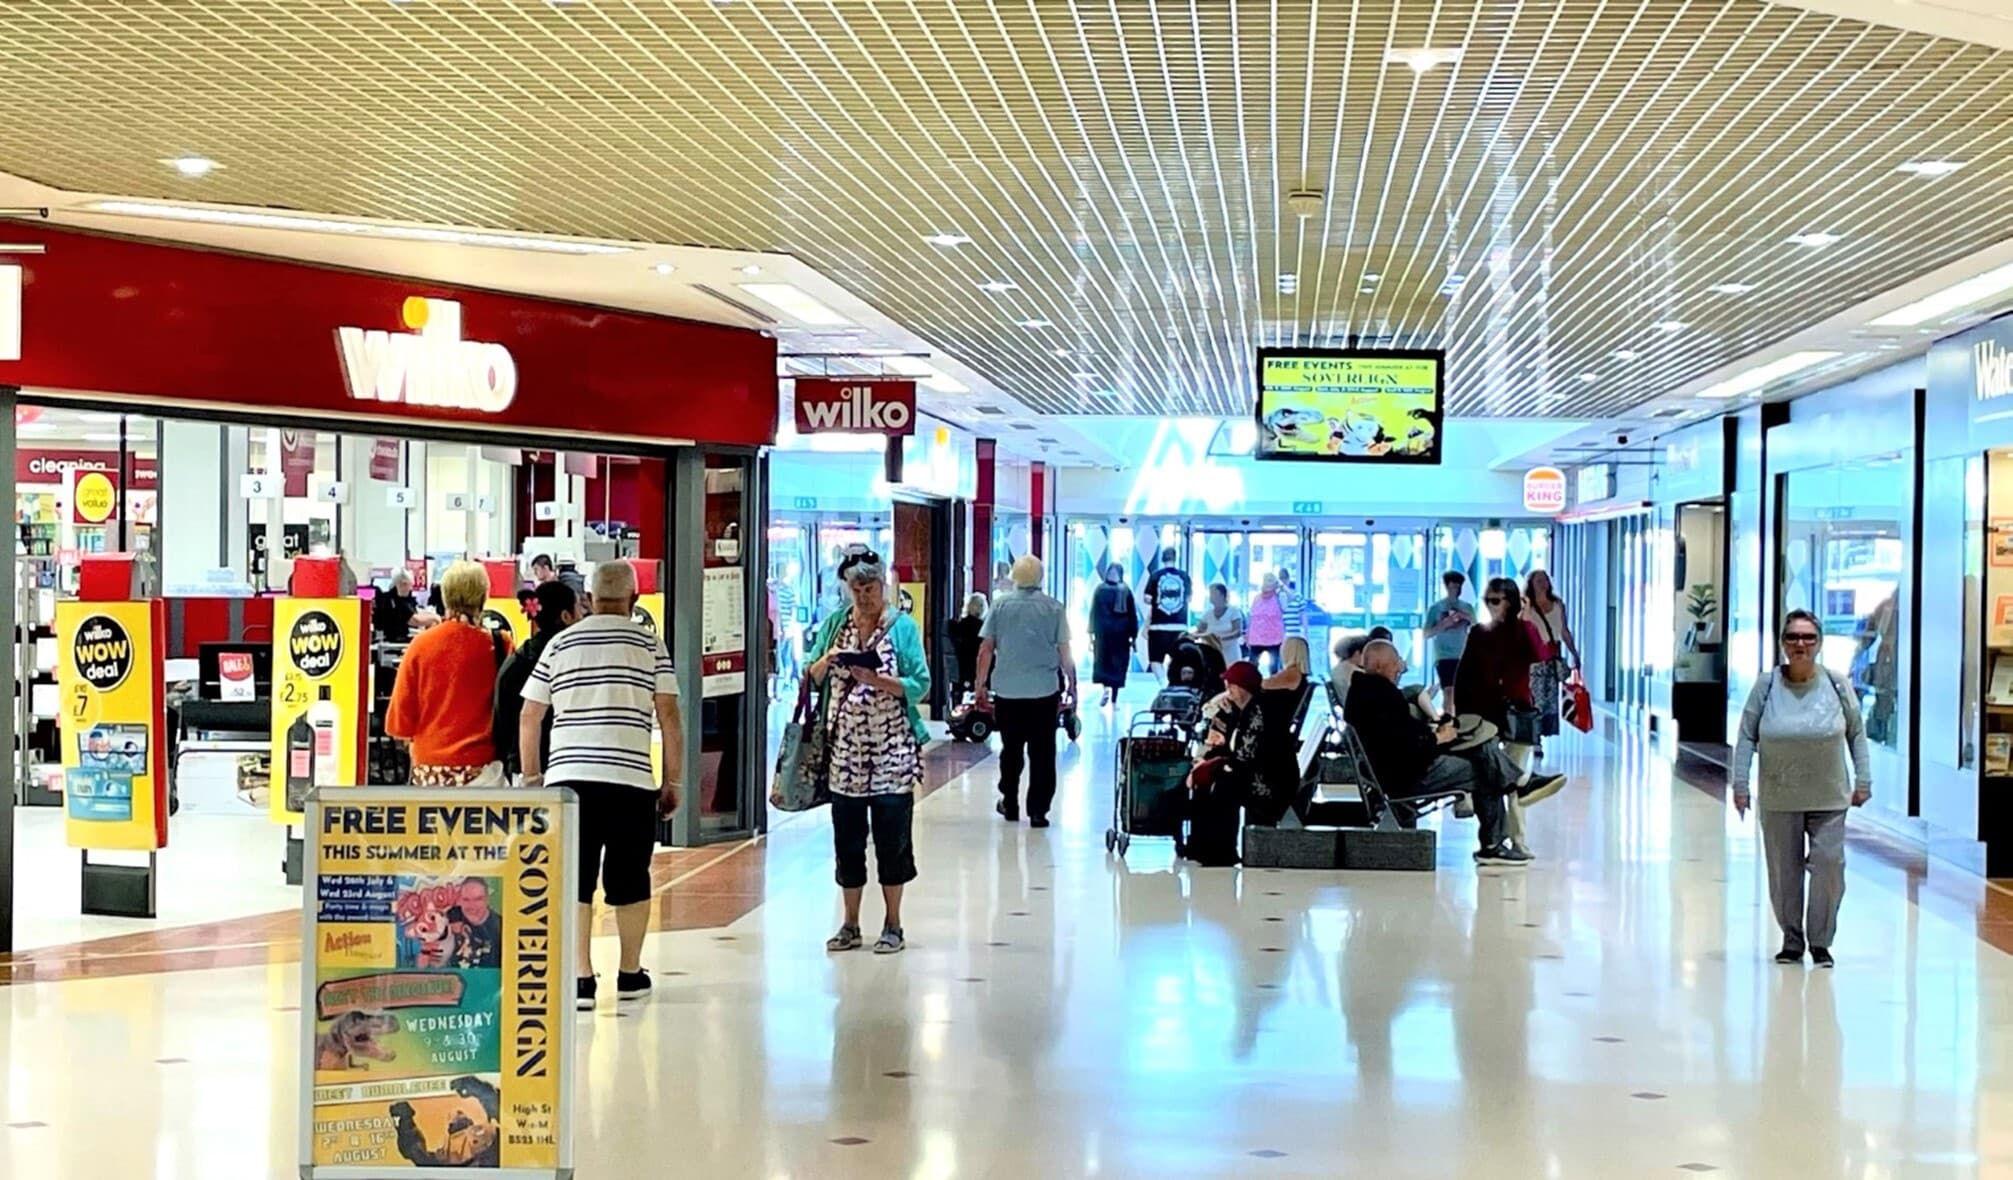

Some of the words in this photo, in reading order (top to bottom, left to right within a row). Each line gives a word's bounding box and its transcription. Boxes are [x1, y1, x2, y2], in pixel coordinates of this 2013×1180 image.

[334, 296, 516, 413] wilko
[1267, 360, 1299, 370] FREE
[1303, 361, 1353, 371] EVENTS
[1302, 373, 1398, 385] SOVEREIGN
[802, 386, 910, 429] wilko
[252, 480, 262, 494] 3
[327, 486, 336, 498] 4
[82, 498, 108, 510] value
[396, 492, 405, 504] 5
[1527, 490, 1562, 502] KING
[84, 625, 113, 641] wilko
[300, 618, 327, 634] wilko
[291, 632, 339, 655] WOW
[76, 639, 128, 665] WOW
[300, 652, 330, 669] deal
[86, 662, 119, 680] deal
[323, 806, 407, 834] FREE
[418, 806, 550, 836] EVENTS
[323, 845, 361, 860] THIS
[366, 845, 441, 860] SUMMER
[446, 845, 467, 860] AT
[473, 845, 508, 860] THE
[320, 888, 340, 898] Wed
[517, 844, 548, 1078] SOVEREIGN
[405, 1011, 494, 1033] WEDNESDAY
[431, 1047, 478, 1063] AUGUST
[513, 1103, 538, 1116] High
[315, 1116, 400, 1133] WEDNESDAY
[334, 1148, 389, 1165] AUGUST
